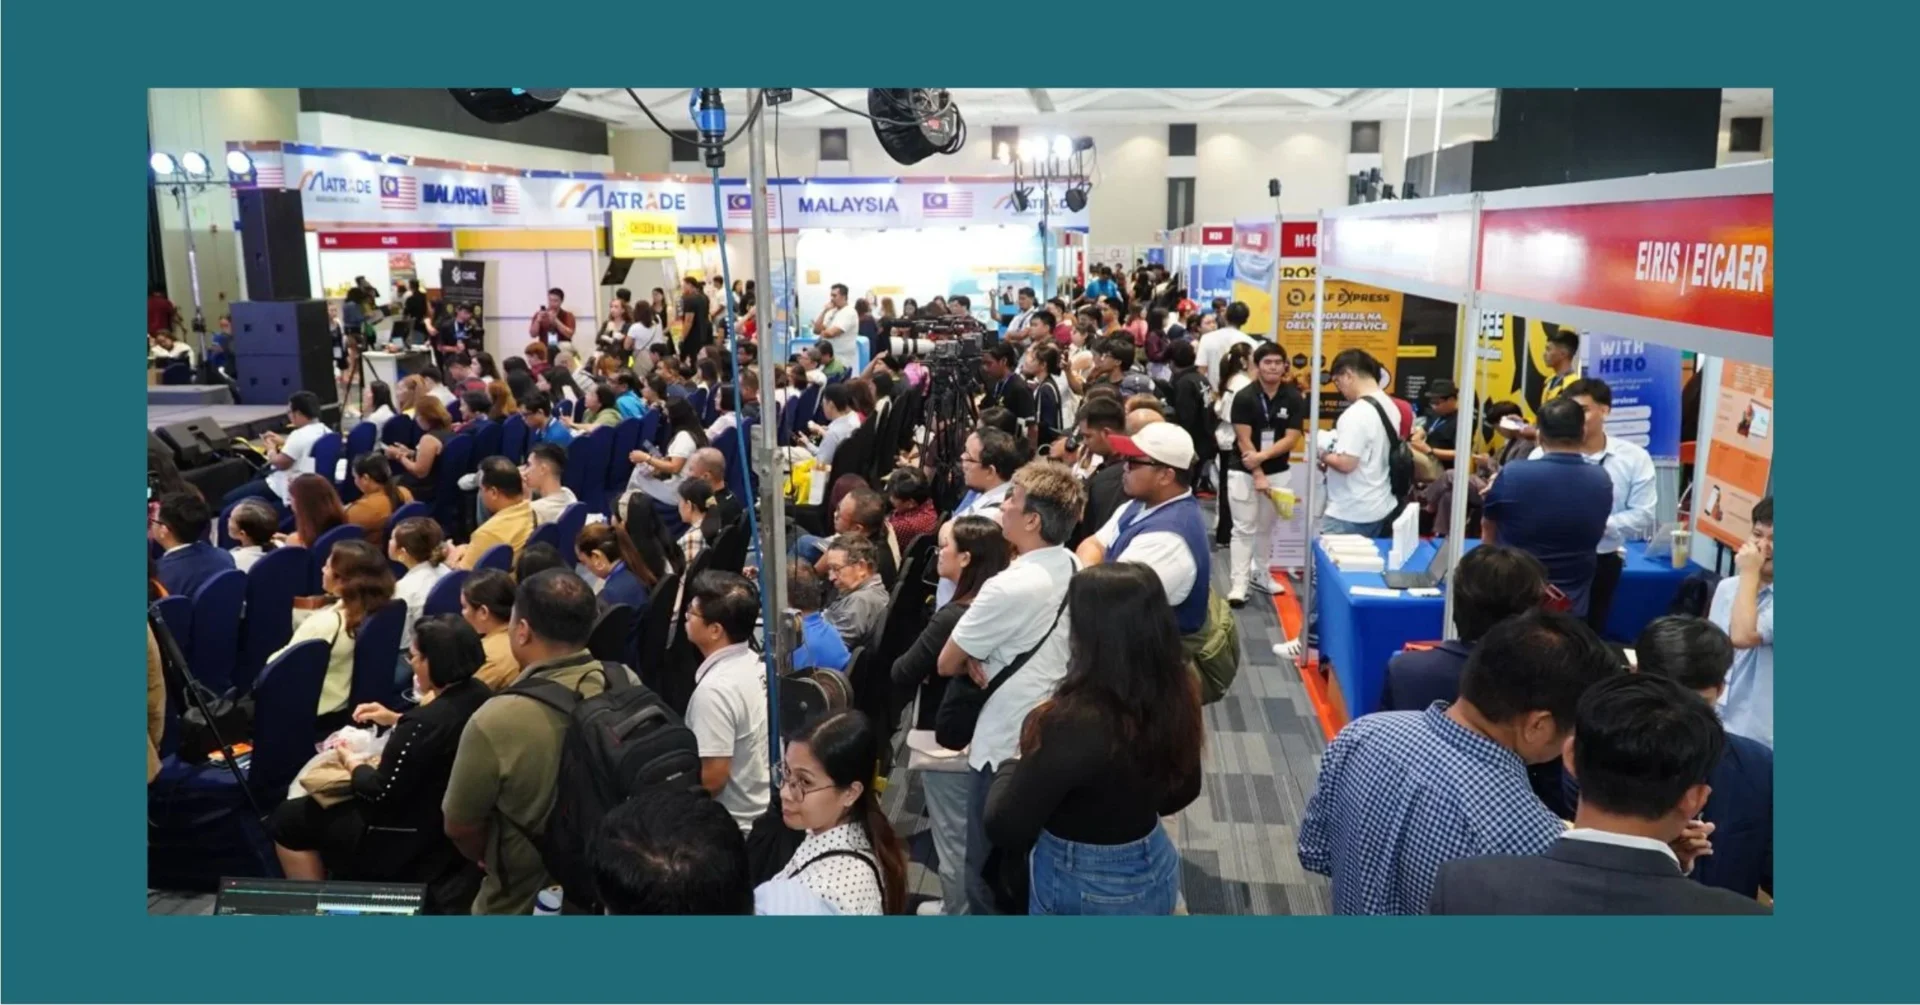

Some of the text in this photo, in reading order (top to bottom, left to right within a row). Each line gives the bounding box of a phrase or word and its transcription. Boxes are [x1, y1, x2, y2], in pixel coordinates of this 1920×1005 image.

[299, 170, 372, 194] MATRADE
[422, 183, 488, 206] MALAYSIA
[556, 182, 686, 210] MATRADE
[798, 196, 899, 213] MALAYSIA
[1635, 240, 1681, 285] EIRIS
[1690, 243, 1768, 293] EICAER
[1337, 289, 1391, 306] EXPRESS
[1286, 321, 1389, 331] DELIVRY SERVICE
[1600, 340, 1645, 356] WITH
[1600, 356, 1647, 373] HERO
